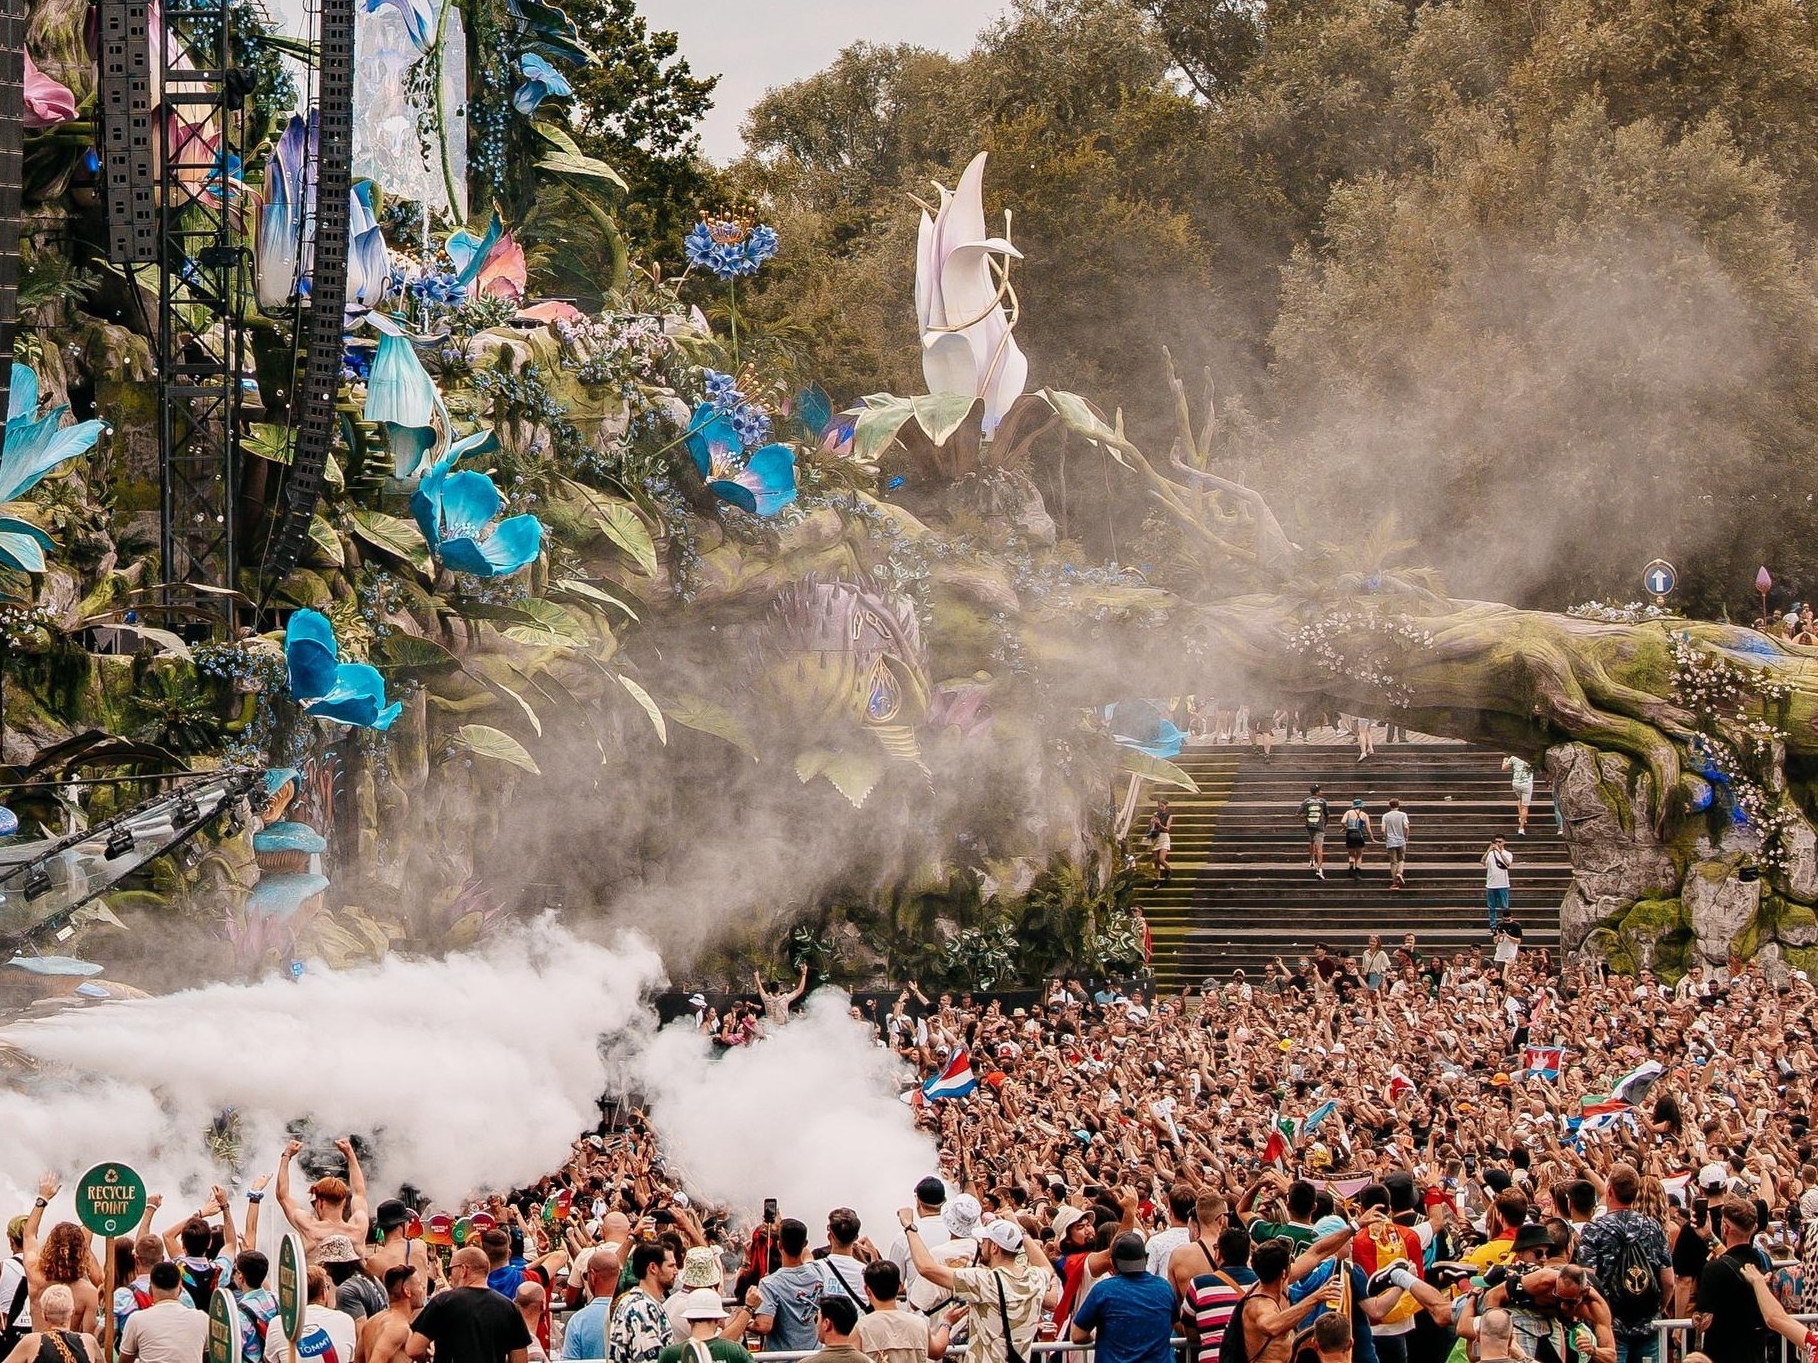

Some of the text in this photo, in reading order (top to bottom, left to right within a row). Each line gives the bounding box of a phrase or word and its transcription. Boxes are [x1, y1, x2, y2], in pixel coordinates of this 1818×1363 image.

[88, 1186, 135, 1200] RECYCLE
[94, 1201, 129, 1214] POINT
[299, 1337, 330, 1353] TOMMY
